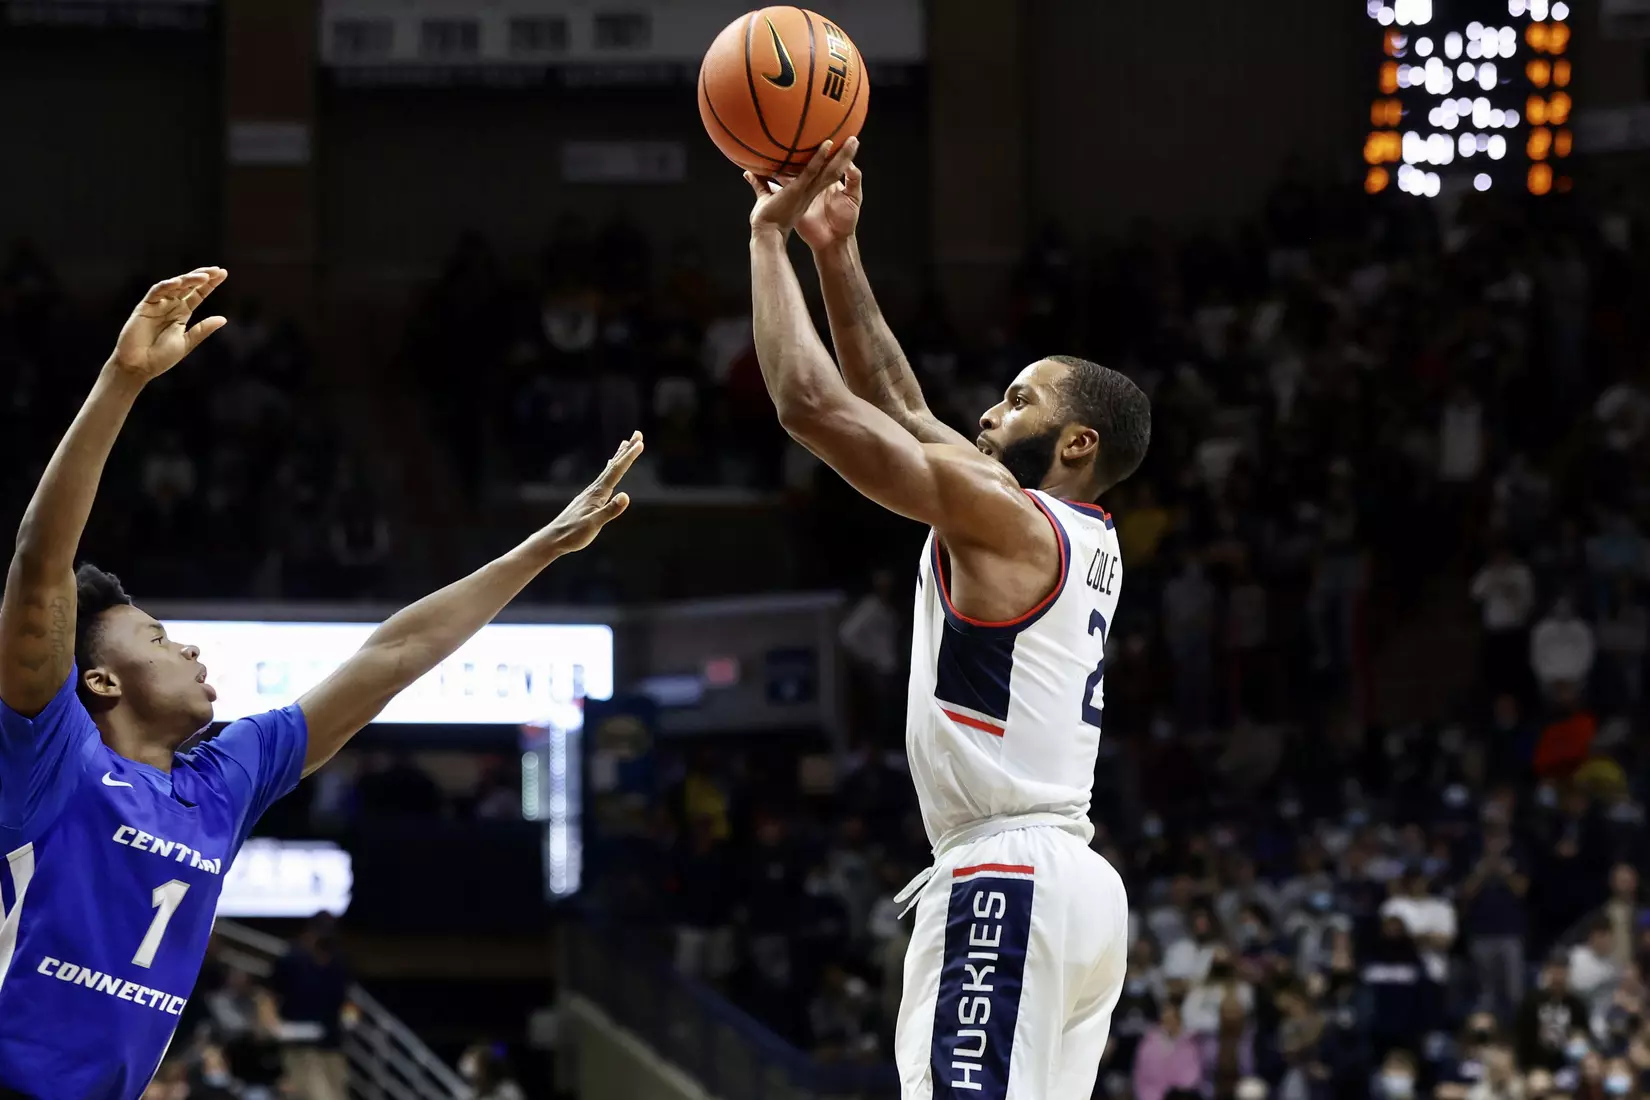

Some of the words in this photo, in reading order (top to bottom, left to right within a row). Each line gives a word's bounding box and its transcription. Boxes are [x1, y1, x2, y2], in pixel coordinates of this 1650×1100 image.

[822, 22, 848, 103] ELITE
[1086, 548, 1117, 596] COLE
[1081, 608, 1107, 729] 2
[131, 879, 191, 969] 1
[37, 956, 188, 1016] CONNECTIC
[951, 890, 1006, 1091] HUSKIES
